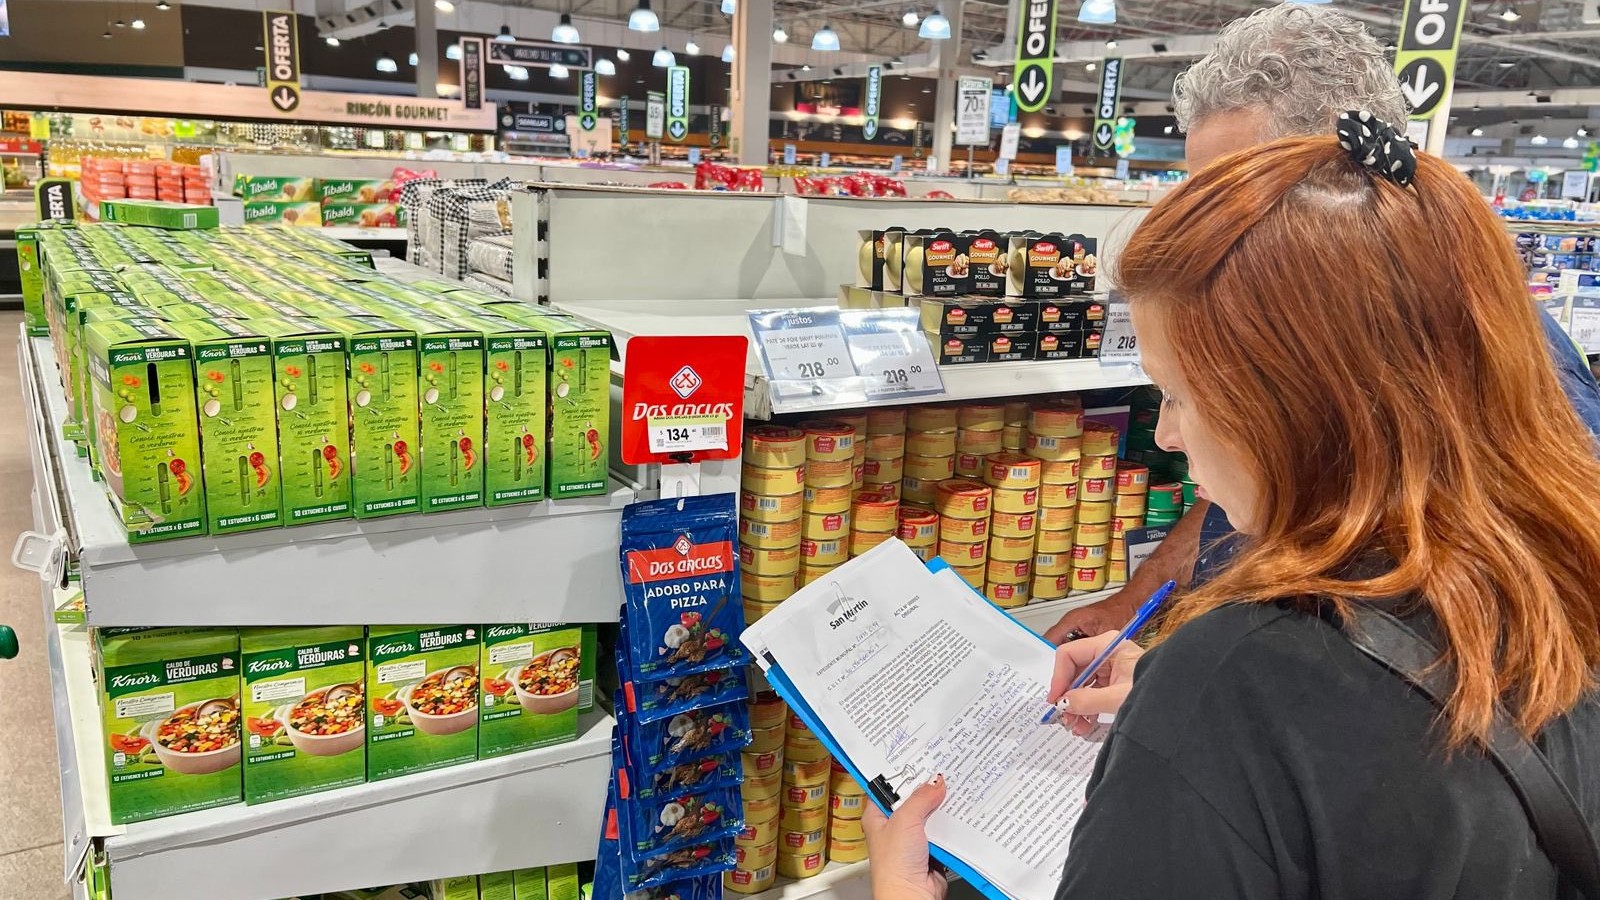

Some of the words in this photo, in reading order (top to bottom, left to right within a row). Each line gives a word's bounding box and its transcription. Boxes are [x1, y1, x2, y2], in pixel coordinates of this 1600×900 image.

[1026, 0, 1048, 55] OFE
[273, 14, 291, 80] OFERTA
[583, 73, 595, 111] OFERTA
[867, 69, 878, 114] OFERTA
[1101, 59, 1119, 118] OFERTA
[346, 101, 391, 117] RINCÓN
[395, 106, 448, 120] GOURMET
[250, 181, 277, 195] Tibaldi
[322, 182, 353, 197] Tibaldi
[47, 184, 65, 218] ERTA
[246, 205, 276, 220] Tibaldi
[323, 207, 354, 221] Tibaldi
[932, 243, 950, 251] Swift
[975, 241, 993, 249] Swift
[1035, 244, 1054, 252] Swift
[788, 316, 812, 327] justos
[280, 345, 303, 353] Knorr
[306, 342, 332, 351] VERDURAS
[355, 343, 378, 351] Knorr
[380, 340, 405, 349] VERDURAS
[425, 342, 447, 350] Knorr
[449, 340, 472, 348] VERDURAS
[491, 342, 513, 350] Knorr
[514, 339, 536, 348] VERDURAS
[579, 338, 601, 347] VERDURAS
[1117, 336, 1137, 349] 218
[146, 350, 176, 359] VERDURAS
[201, 349, 227, 358] Knorr
[230, 346, 258, 355] VERDURAS
[114, 353, 142, 362] Knorr
[798, 362, 825, 378] 218
[826, 357, 839, 366] .00
[883, 369, 908, 384] 218
[909, 365, 922, 373] .00
[666, 428, 689, 441] 134
[373, 501, 394, 509] ESTUCHES
[302, 508, 324, 516] ESTUCHES
[228, 517, 251, 525] ESTUCHES
[148, 526, 172, 534] ESTUCHES
[647, 583, 689, 598] ADOBO
[693, 579, 726, 591] PARA
[670, 595, 707, 609] PIZZA
[829, 613, 845, 630] San
[487, 625, 524, 638] Knorr
[420, 633, 462, 649] VERDURAS
[375, 642, 415, 656] Knorr
[298, 649, 345, 665] VERDURAS
[166, 661, 183, 669] CALDO
[166, 663, 218, 680] VERDURAS
[248, 659, 293, 674] Knorr
[111, 673, 160, 688] Knorr
